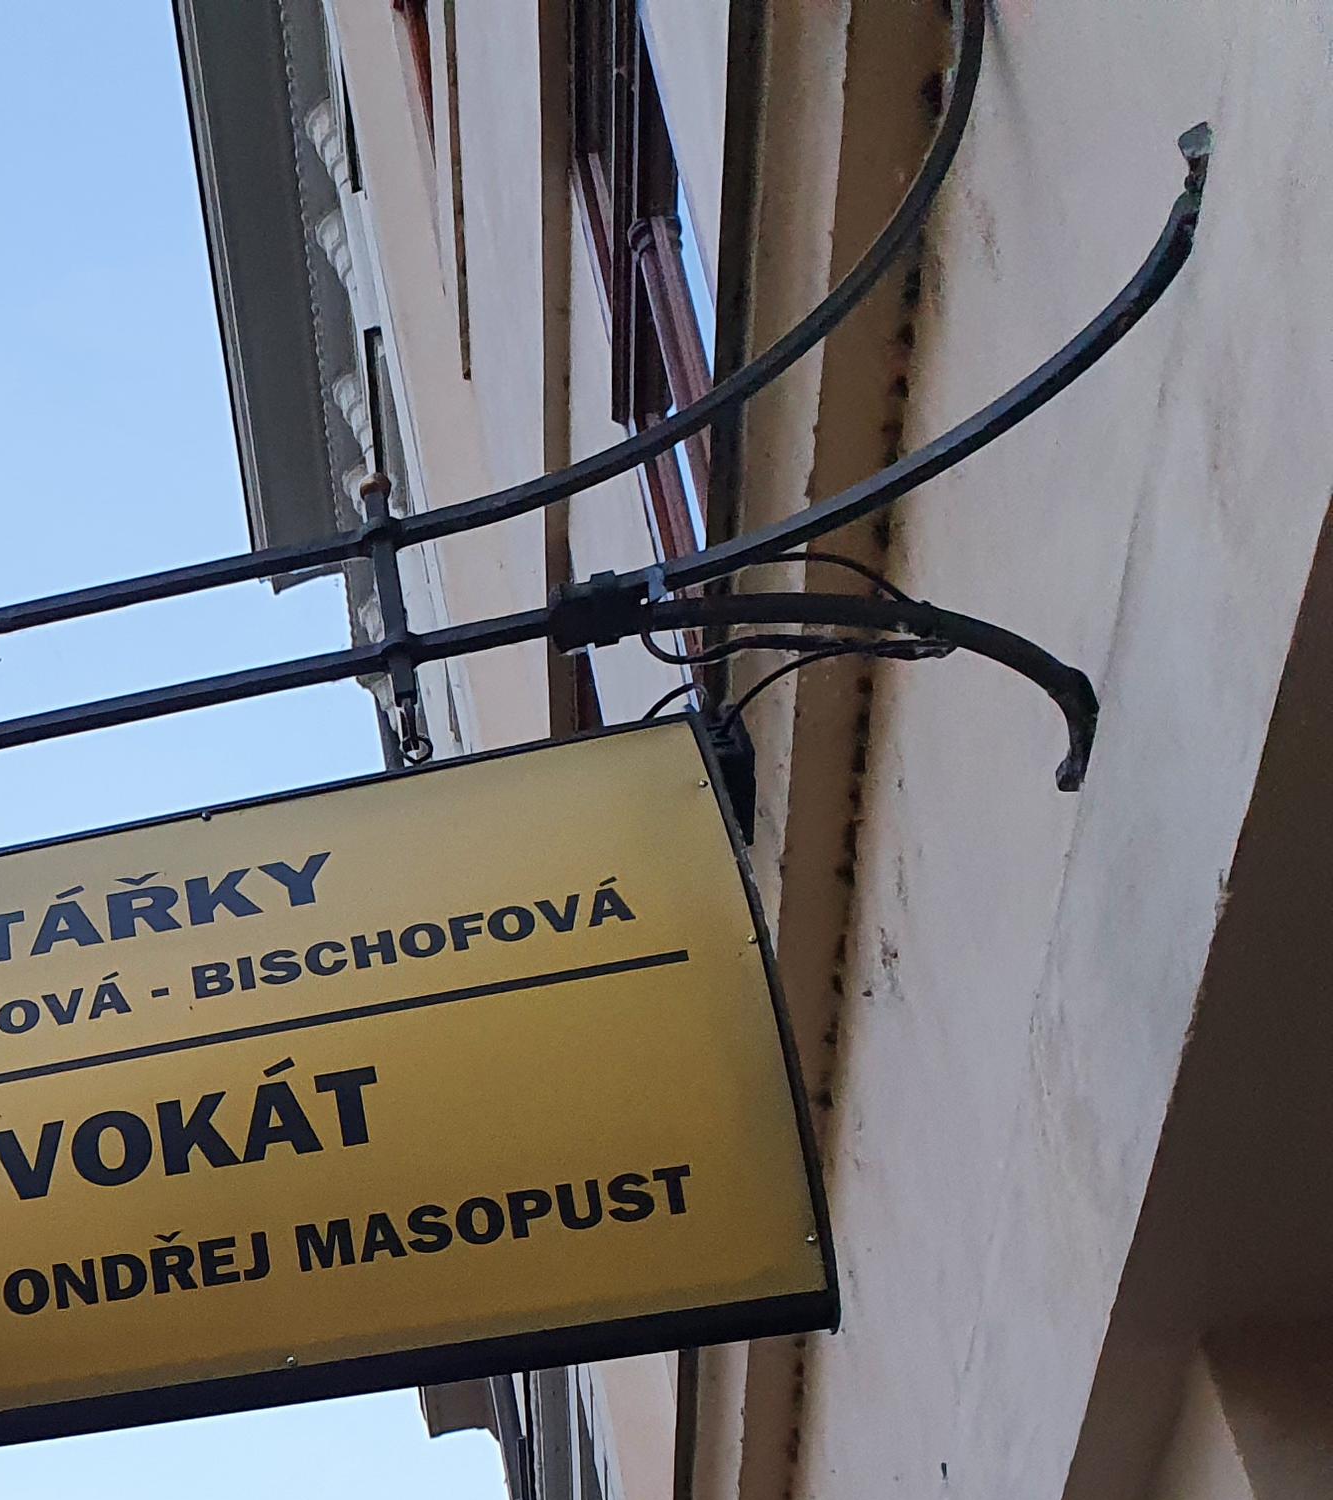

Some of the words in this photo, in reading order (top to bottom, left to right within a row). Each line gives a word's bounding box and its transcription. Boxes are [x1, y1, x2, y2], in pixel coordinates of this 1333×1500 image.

[150, 986, 171, 998] -
[190, 876, 637, 999] BISCHOFOVÁ
[3, 1230, 272, 1316] ONDŘEJ
[294, 1164, 692, 1273] MASOPUST
